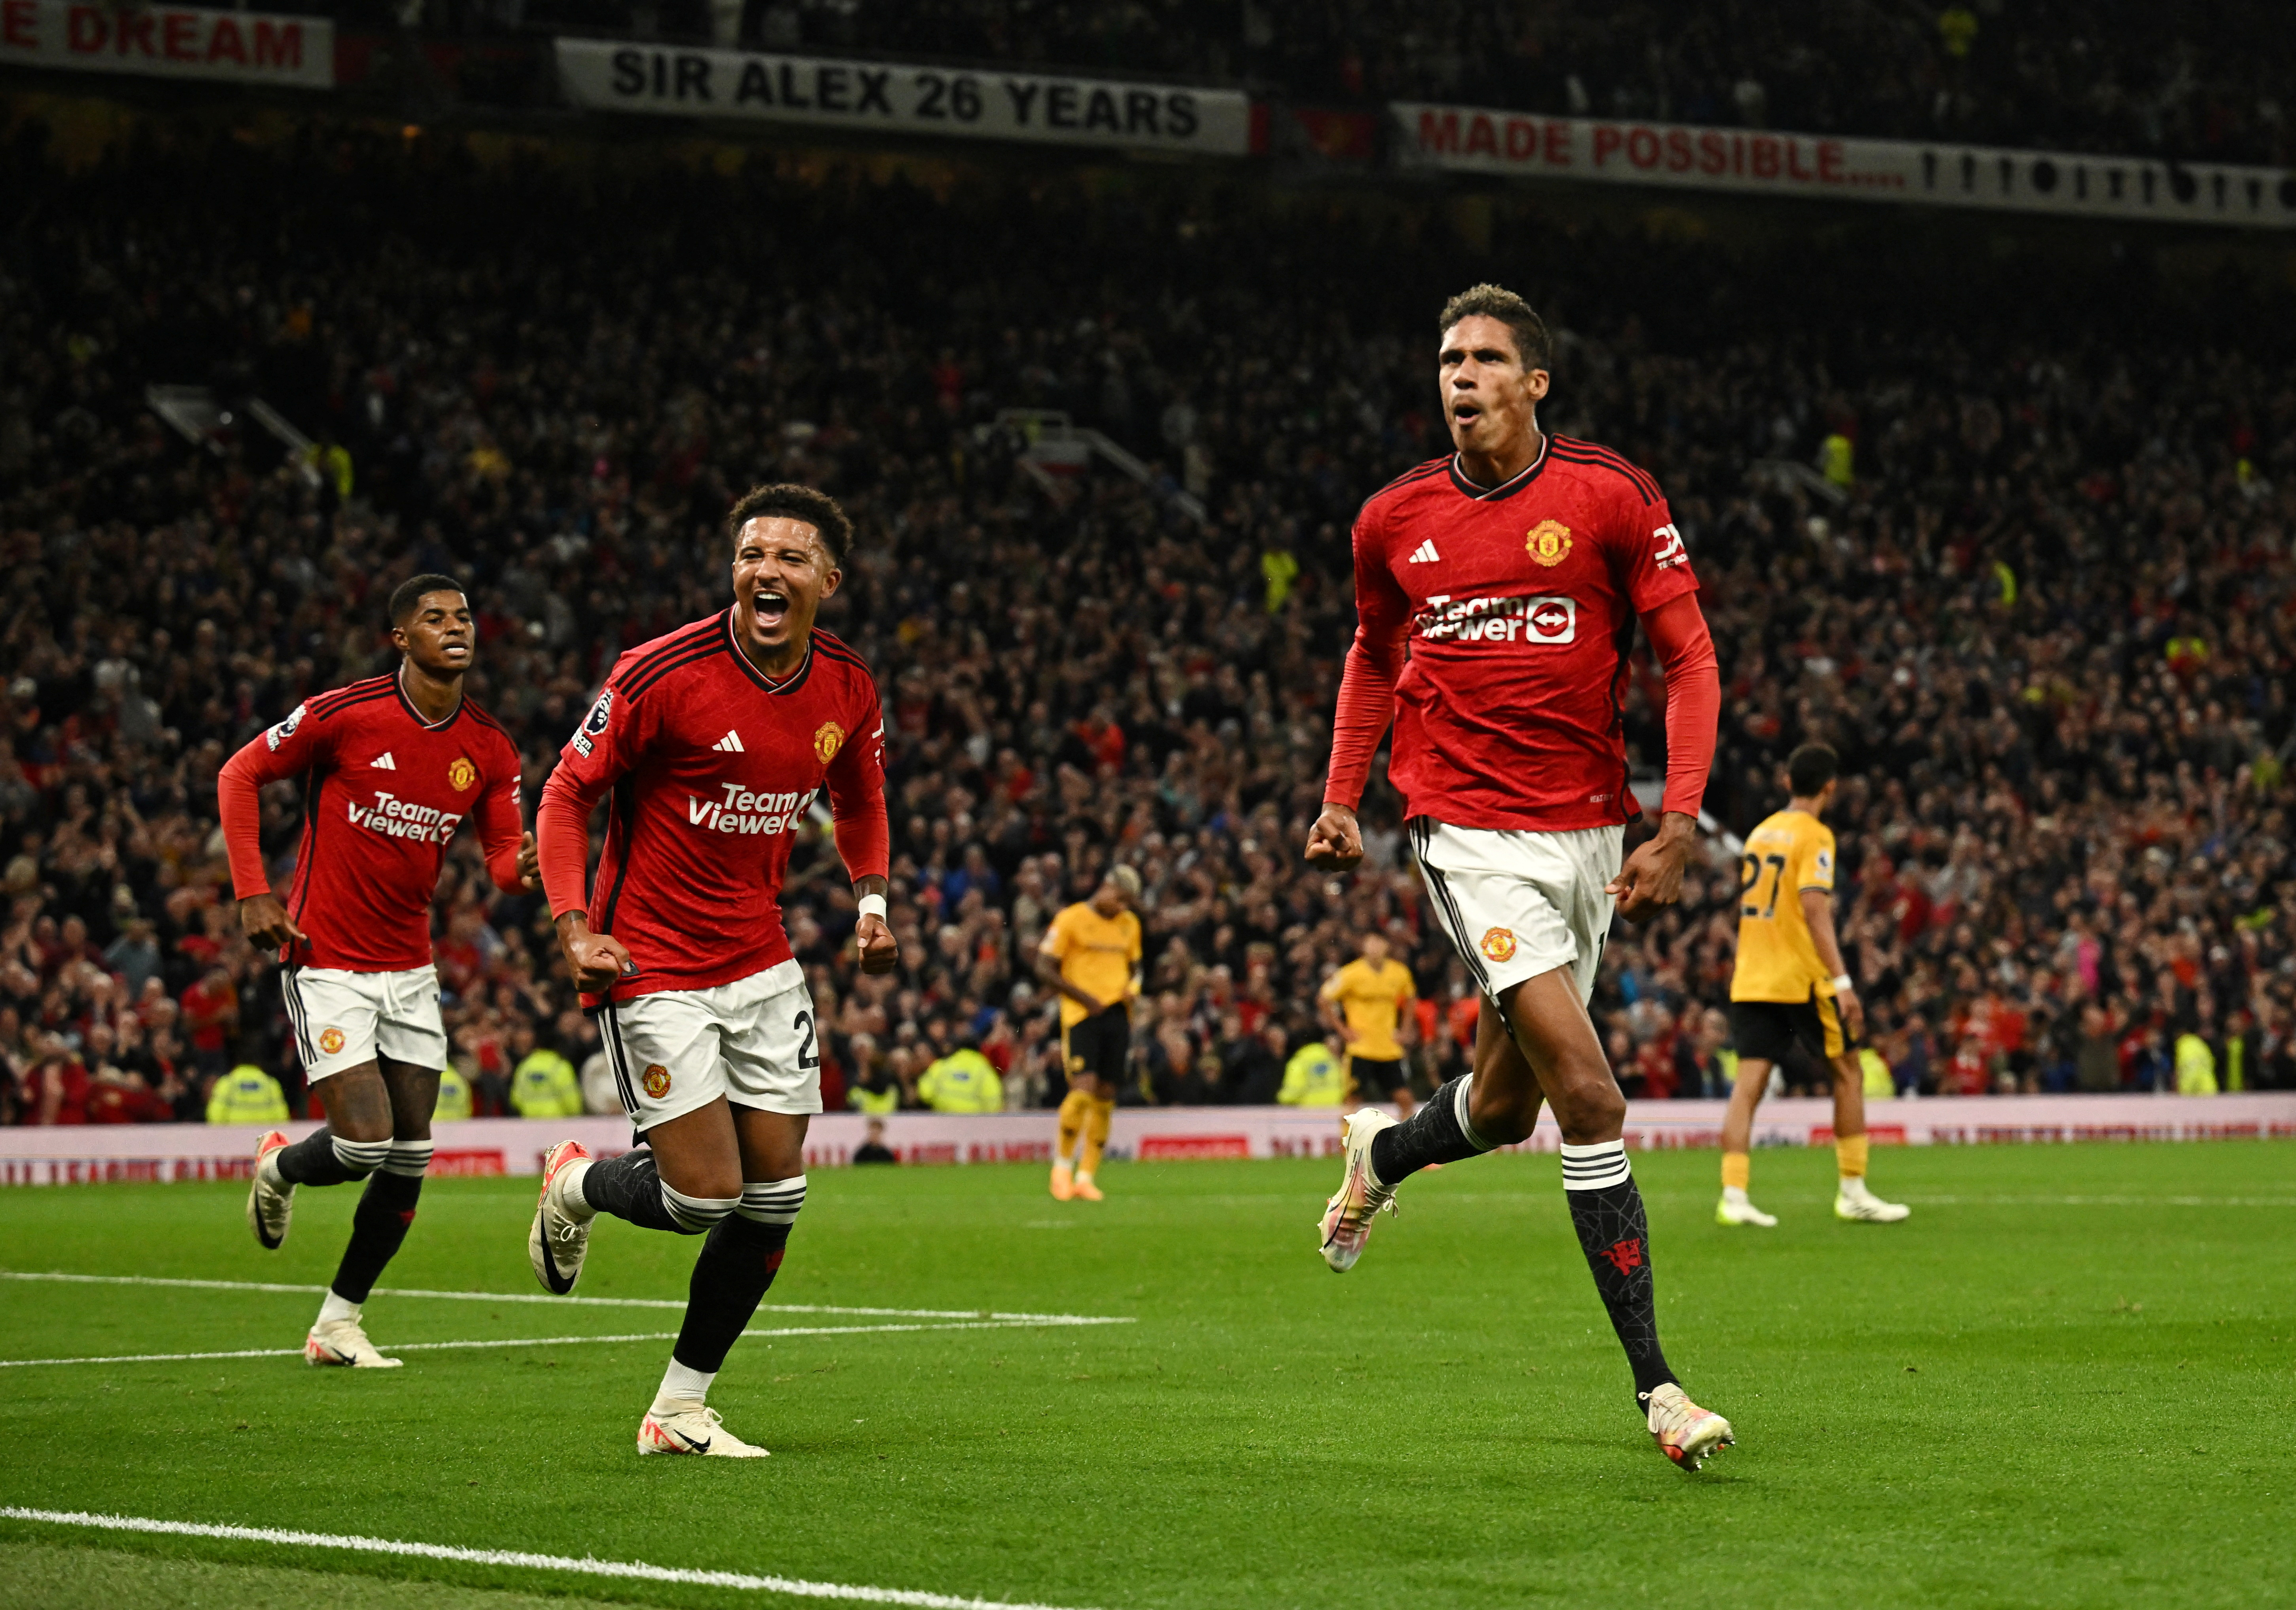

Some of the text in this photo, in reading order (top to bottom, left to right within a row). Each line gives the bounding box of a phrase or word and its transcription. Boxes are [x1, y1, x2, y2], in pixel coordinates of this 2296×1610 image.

[2, 1, 302, 68] E DREAM
[612, 50, 1198, 137] SIR ALEX 26 YEARS
[1420, 111, 1572, 164] MADE
[1426, 595, 1524, 621] Team
[374, 791, 440, 824] Team
[689, 795, 791, 835] Viewer
[721, 782, 798, 813] Team
[348, 801, 433, 841] Viewer
[1742, 853, 1785, 916] 27
